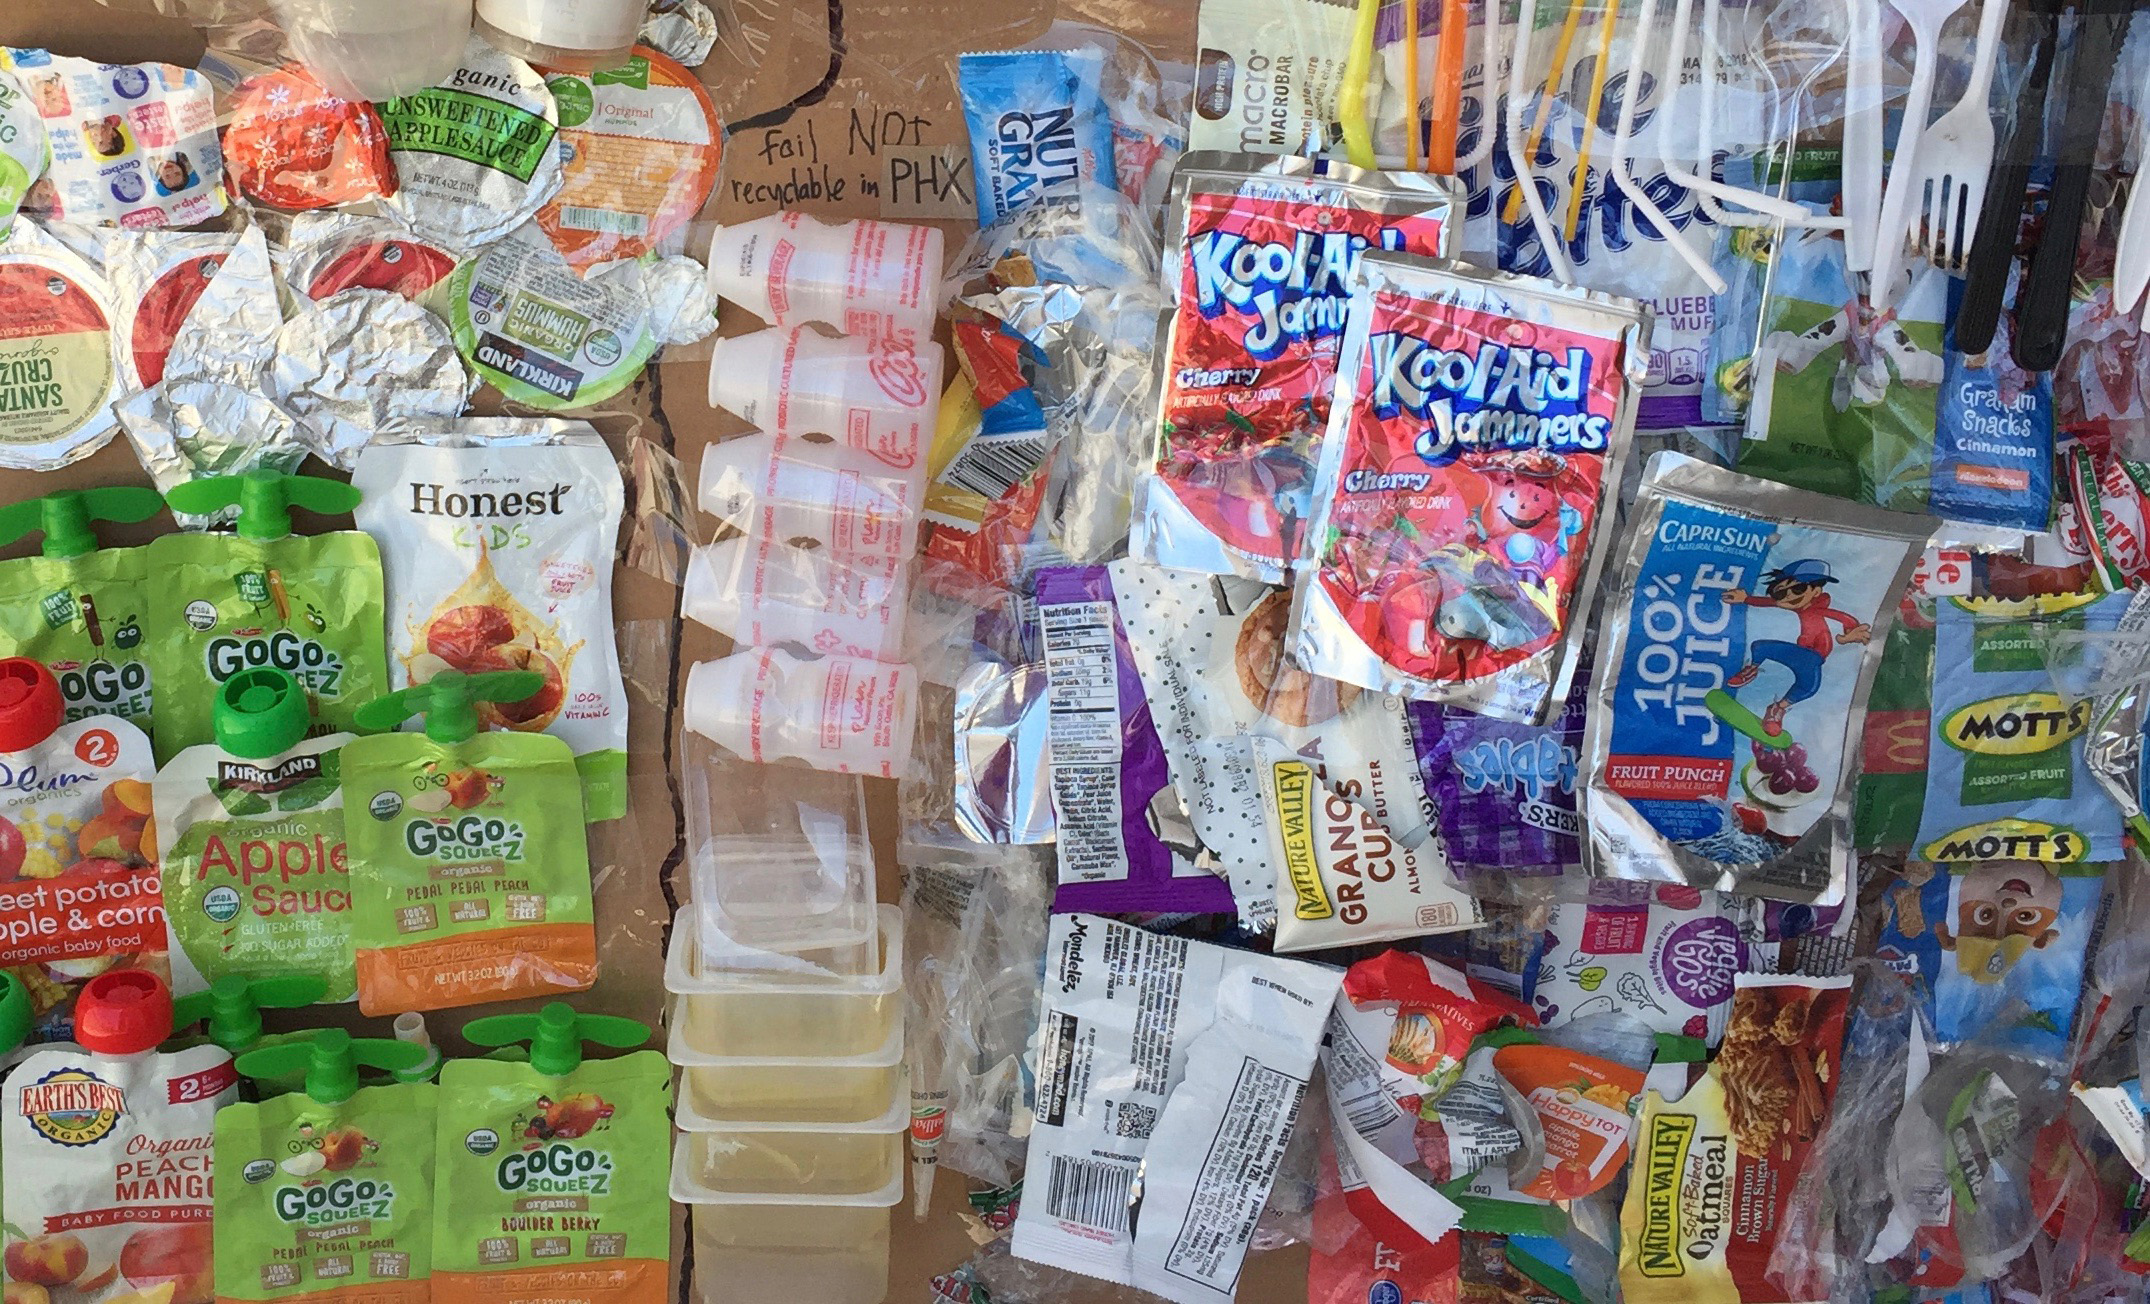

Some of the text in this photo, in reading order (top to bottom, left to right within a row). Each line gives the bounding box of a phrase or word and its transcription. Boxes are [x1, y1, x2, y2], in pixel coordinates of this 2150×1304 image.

[452, 66, 522, 96] ganic
[605, 103, 654, 119] Original
[1269, 55, 1293, 145] MACROBAR
[385, 96, 541, 147] UNSWEETENED
[391, 121, 527, 169] APPLESAUCE
[758, 119, 817, 165] foil
[98, 159, 141, 177] Gerber
[988, 138, 1007, 219] SOFT BAKED
[731, 164, 846, 210] recyclable
[860, 173, 880, 197] in
[890, 155, 972, 204] PHX
[514, 297, 585, 344] HUMMUS
[508, 319, 574, 354] ORGANIC
[0, 358, 53, 384] CRUZ
[478, 346, 574, 397] KIRKLAND
[1175, 367, 1261, 390] Cherry
[1370, 332, 1592, 416] Kool-Aid
[1415, 399, 1609, 465] Jammers
[1961, 411, 2032, 438] Snacks
[1956, 438, 2037, 458] Cinnamon
[1345, 470, 1431, 493] Cherry
[409, 482, 571, 518] Honest
[49, 601, 76, 622] FRUIT
[1044, 604, 1108, 618] Nutrition Facts
[1633, 573, 1685, 713] 100%
[1675, 563, 1746, 747] JUICE
[1980, 638, 2048, 651] ASSORTED
[1160, 642, 1215, 814] NOT LABELED FOR INDIVIDUAL SALE
[86, 736, 107, 761] 2
[225, 757, 317, 785] KIRKLAND
[1611, 765, 1726, 783] FRUIT PUNCH
[2030, 768, 2066, 780] FRUIT
[7, 787, 81, 808] organics
[1369, 759, 1389, 819] BUTTER
[227, 822, 308, 838] organic
[406, 816, 505, 856] GoGo
[1277, 766, 1328, 915] NATURE VALLEY
[197, 834, 349, 887] Apple
[440, 841, 522, 861] SQUEEZ
[440, 865, 493, 879] organic
[55, 874, 162, 912] potato
[210, 894, 233, 904] USDA
[407, 880, 530, 901] PEDAL PEDAL PEACH
[67, 905, 167, 931] & corn
[455, 909, 488, 921] NATURAL
[513, 907, 537, 919] FREE
[1421, 907, 1439, 927] 180
[2, 933, 142, 961] organic baby food
[262, 937, 302, 952] SUGAR
[1696, 929, 1739, 999] Veggie
[22, 1082, 125, 1116] EARTH'S BEST
[179, 1078, 201, 1101] 2
[37, 1112, 113, 1142] ORGANIC
[473, 1134, 491, 1142] USDA
[1277, 1122, 1295, 1147] Facts
[1256, 1133, 1274, 1164] Calories
[116, 1156, 215, 1181] PEACH
[498, 1144, 595, 1190] GoGo
[116, 1176, 215, 1202] MANG
[527, 1174, 608, 1194] SQUEEZ
[1474, 1185, 1493, 1197] OZ)
[1643, 1120, 1690, 1271] NATURE VALLEY
[1682, 1153, 1704, 1238] Soft-Baked
[276, 1178, 376, 1221] GoGo
[526, 1199, 577, 1211] organic
[1248, 1199, 1262, 1221] pack
[1686, 1134, 1728, 1261] Oatmeal
[1722, 1176, 1733, 1224] SQUARES
[1736, 1165, 1755, 1237] Cinnamon
[1746, 1156, 1769, 1243] Brown Sugar
[62, 1209, 214, 1228] BABY FOOD PURE
[307, 1200, 390, 1225] SQUEEZ
[502, 1216, 600, 1232] BOULDER BERRY
[308, 1225, 360, 1240] organic
[272, 1238, 395, 1260] PEDAL PEDAL PEACH
[376, 1264, 401, 1275] FREE
